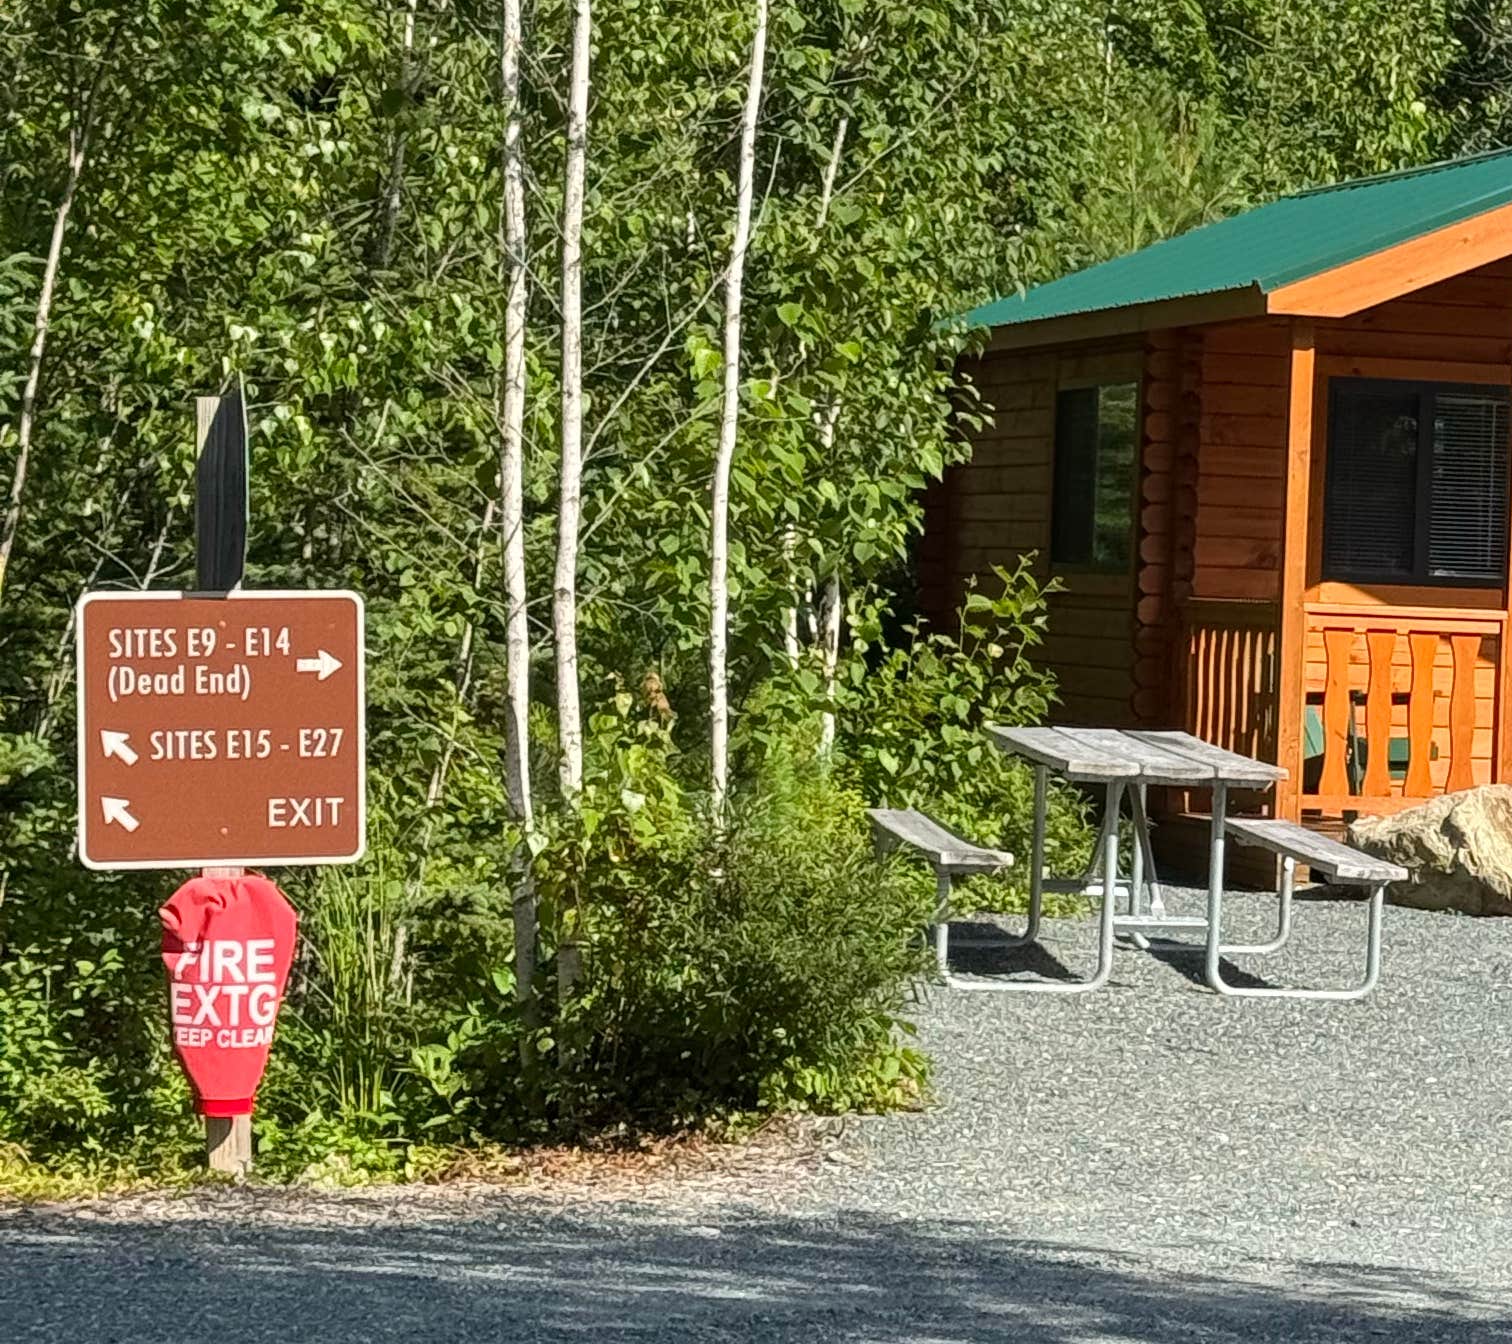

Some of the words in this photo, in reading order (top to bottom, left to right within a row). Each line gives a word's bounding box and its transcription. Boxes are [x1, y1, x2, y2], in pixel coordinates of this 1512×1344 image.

[108, 628, 177, 658] SITES
[187, 627, 216, 657] E9
[245, 627, 291, 656] E14
[108, 664, 185, 702] (Dead
[195, 663, 251, 701] End)
[150, 730, 217, 760] SITES
[227, 729, 271, 759] E15
[299, 728, 343, 757] E27
[268, 797, 345, 827] EXIT
[171, 982, 277, 1026] EXTG
[173, 1026, 214, 1047] EEP
